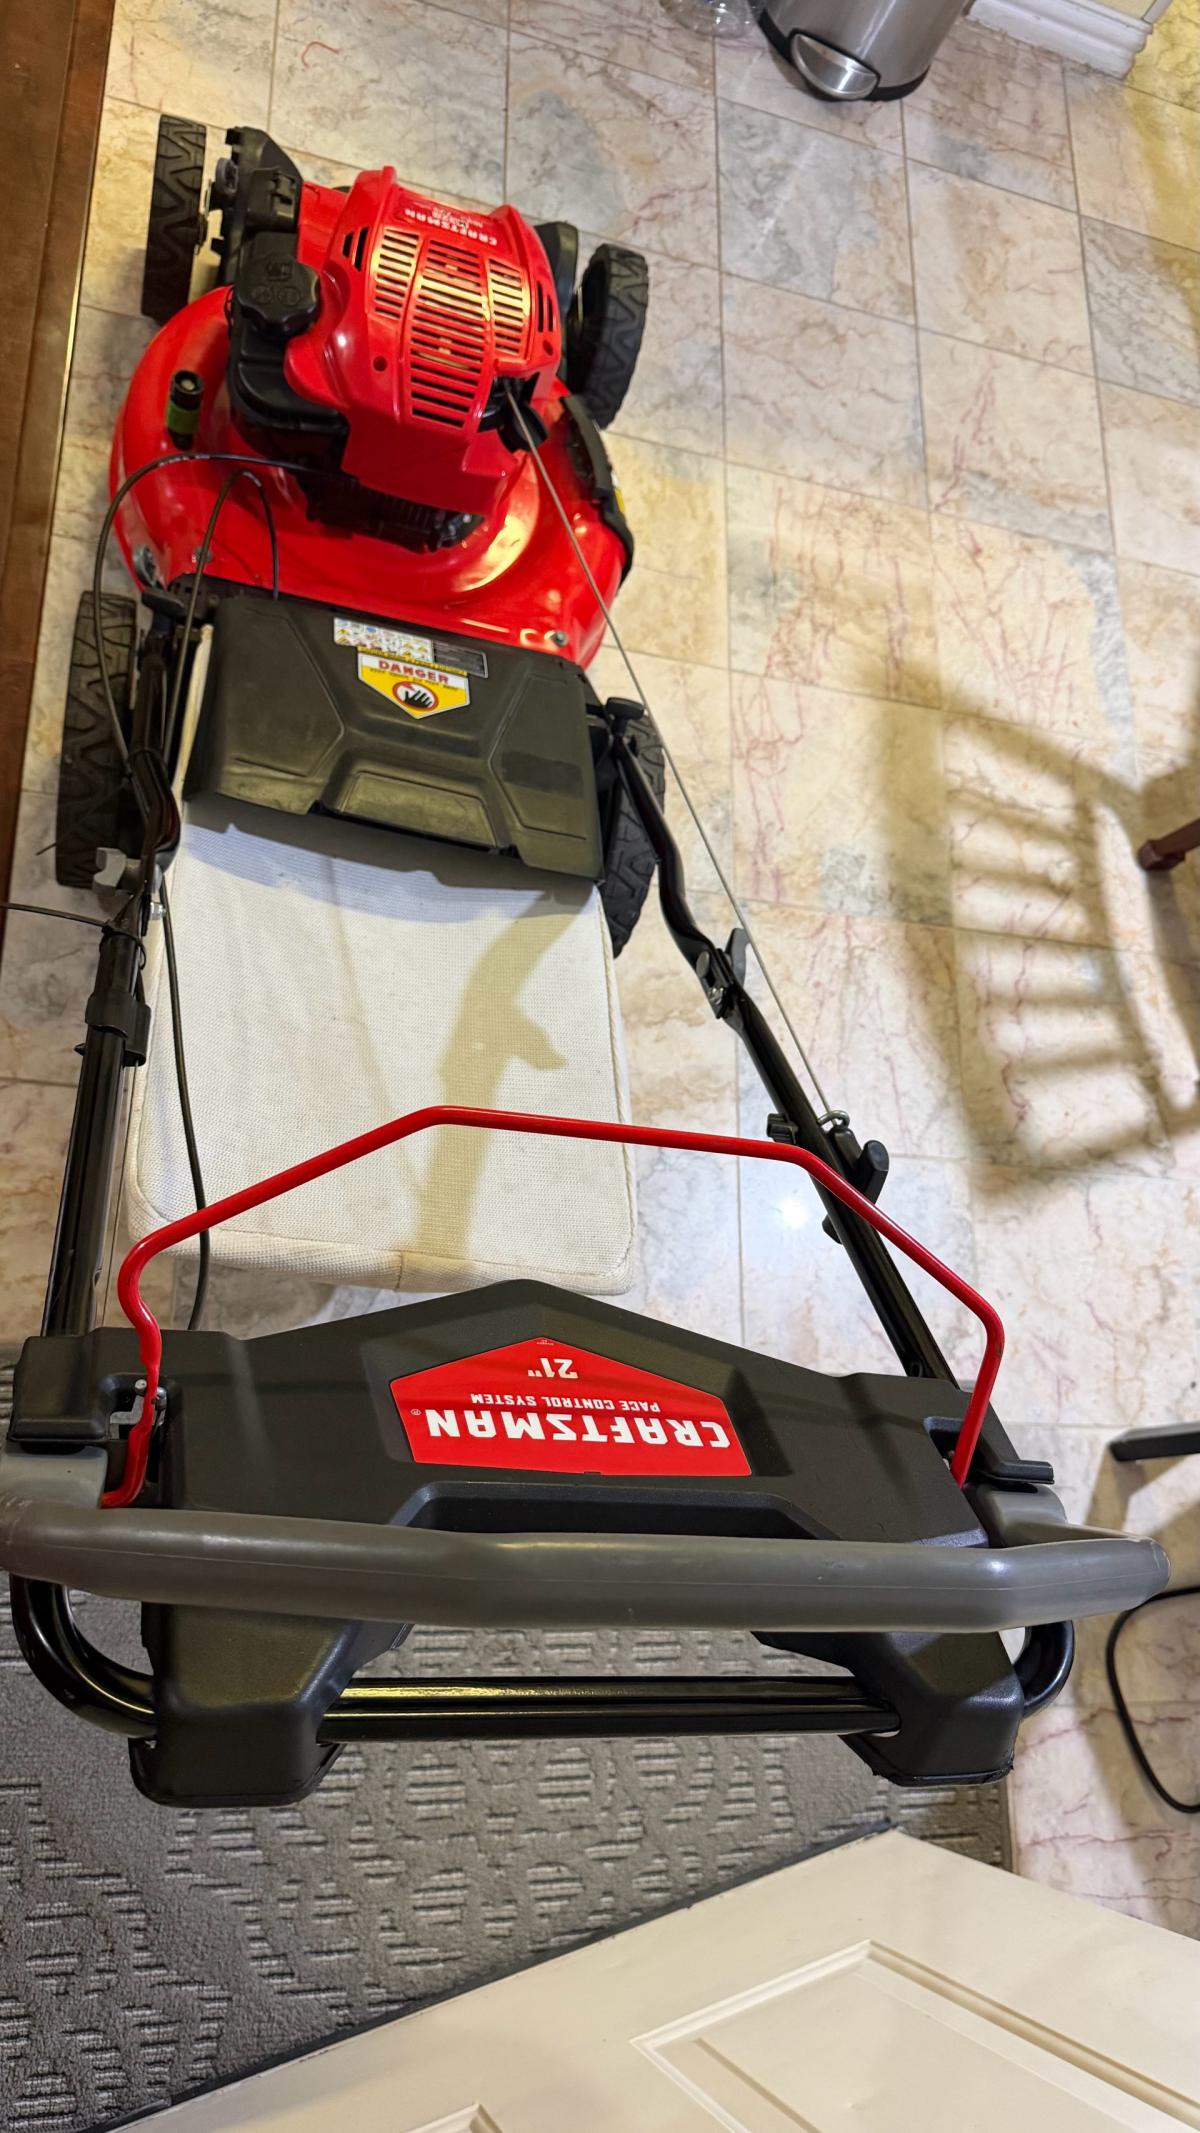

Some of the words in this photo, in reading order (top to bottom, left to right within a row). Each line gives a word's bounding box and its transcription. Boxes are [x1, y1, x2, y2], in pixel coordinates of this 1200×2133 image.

[404, 208, 498, 246] CRAFTSMAN
[378, 659, 449, 684] DANGER
[527, 1357, 579, 1380] 21"
[470, 1392, 537, 1406] SYSTEM
[541, 1396, 615, 1411] CONTROL
[619, 1399, 661, 1413] PACE
[425, 1409, 731, 1448] CRAFTSMAN
